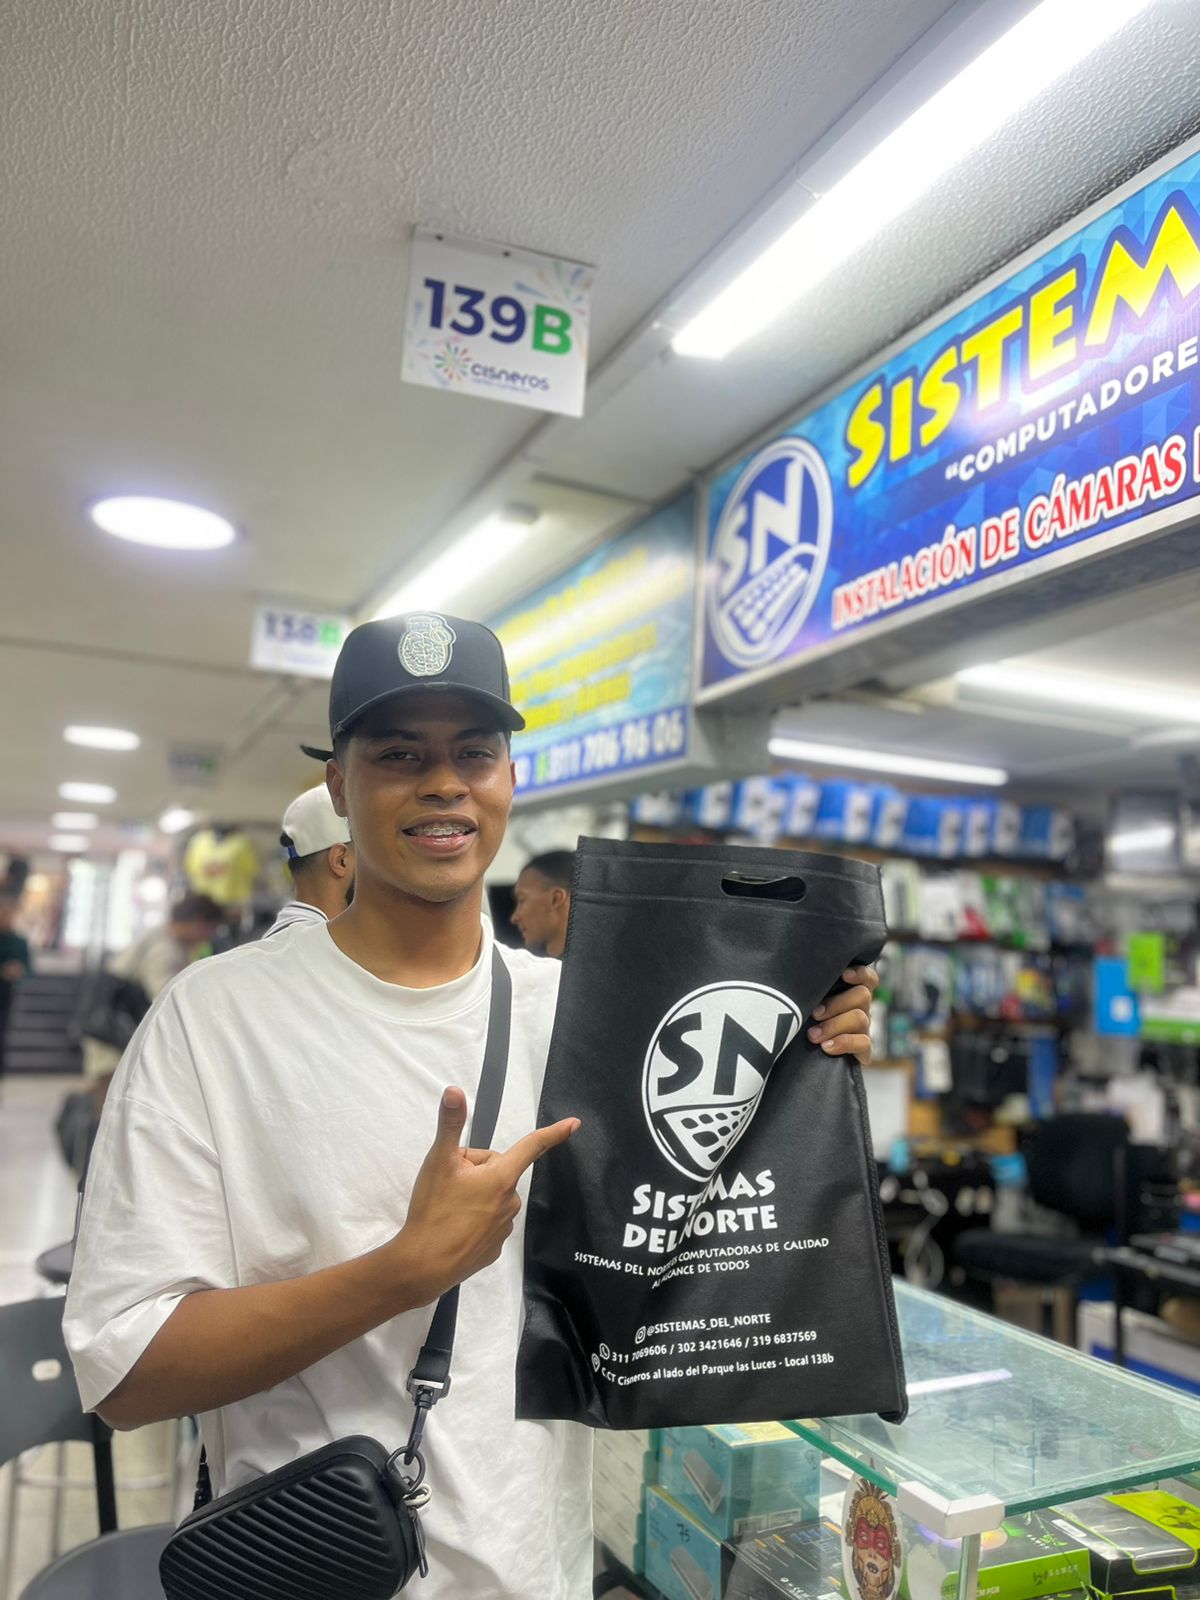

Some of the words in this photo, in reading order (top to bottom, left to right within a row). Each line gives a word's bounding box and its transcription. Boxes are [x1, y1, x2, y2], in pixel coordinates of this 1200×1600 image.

[424, 277, 573, 355] 139B
[846, 206, 1200, 488] SISTEM
[715, 457, 804, 598] SN
[832, 524, 976, 630] INSTALACIÓN
[980, 507, 1020, 569] DE
[1024, 435, 1187, 549] CÁMARAS
[656, 1011, 794, 1097] SN
[623, 1223, 678, 1253] DEL
[679, 1205, 778, 1244] NORTE
[574, 1251, 622, 1271] SISTEMAS
[624, 1262, 644, 1275] DEL
[678, 1244, 763, 1262] COMPUTADORAS
[766, 1242, 781, 1252] DE
[783, 1238, 830, 1251] CALIDAD
[697, 1263, 711, 1273] DE
[713, 1260, 750, 1272] TODOS
[612, 1352, 629, 1364] 311
[631, 1344, 667, 1362] 7069606
[677, 1342, 696, 1353] 302
[698, 1338, 743, 1352] 3421646
[752, 1335, 771, 1346] 319
[773, 1330, 817, 1344] 6837569
[646, 1313, 771, 1336] @SISTEMAS_DEL_NORTE
[617, 1371, 651, 1386] Cisneros
[652, 1369, 661, 1380] al
[663, 1367, 684, 1378] lado
[686, 1365, 699, 1376] del
[701, 1364, 735, 1376] Parque
[736, 1361, 749, 1372] las
[751, 1360, 777, 1371] Luces
[784, 1355, 809, 1367] Local
[811, 1352, 834, 1365] 138b
